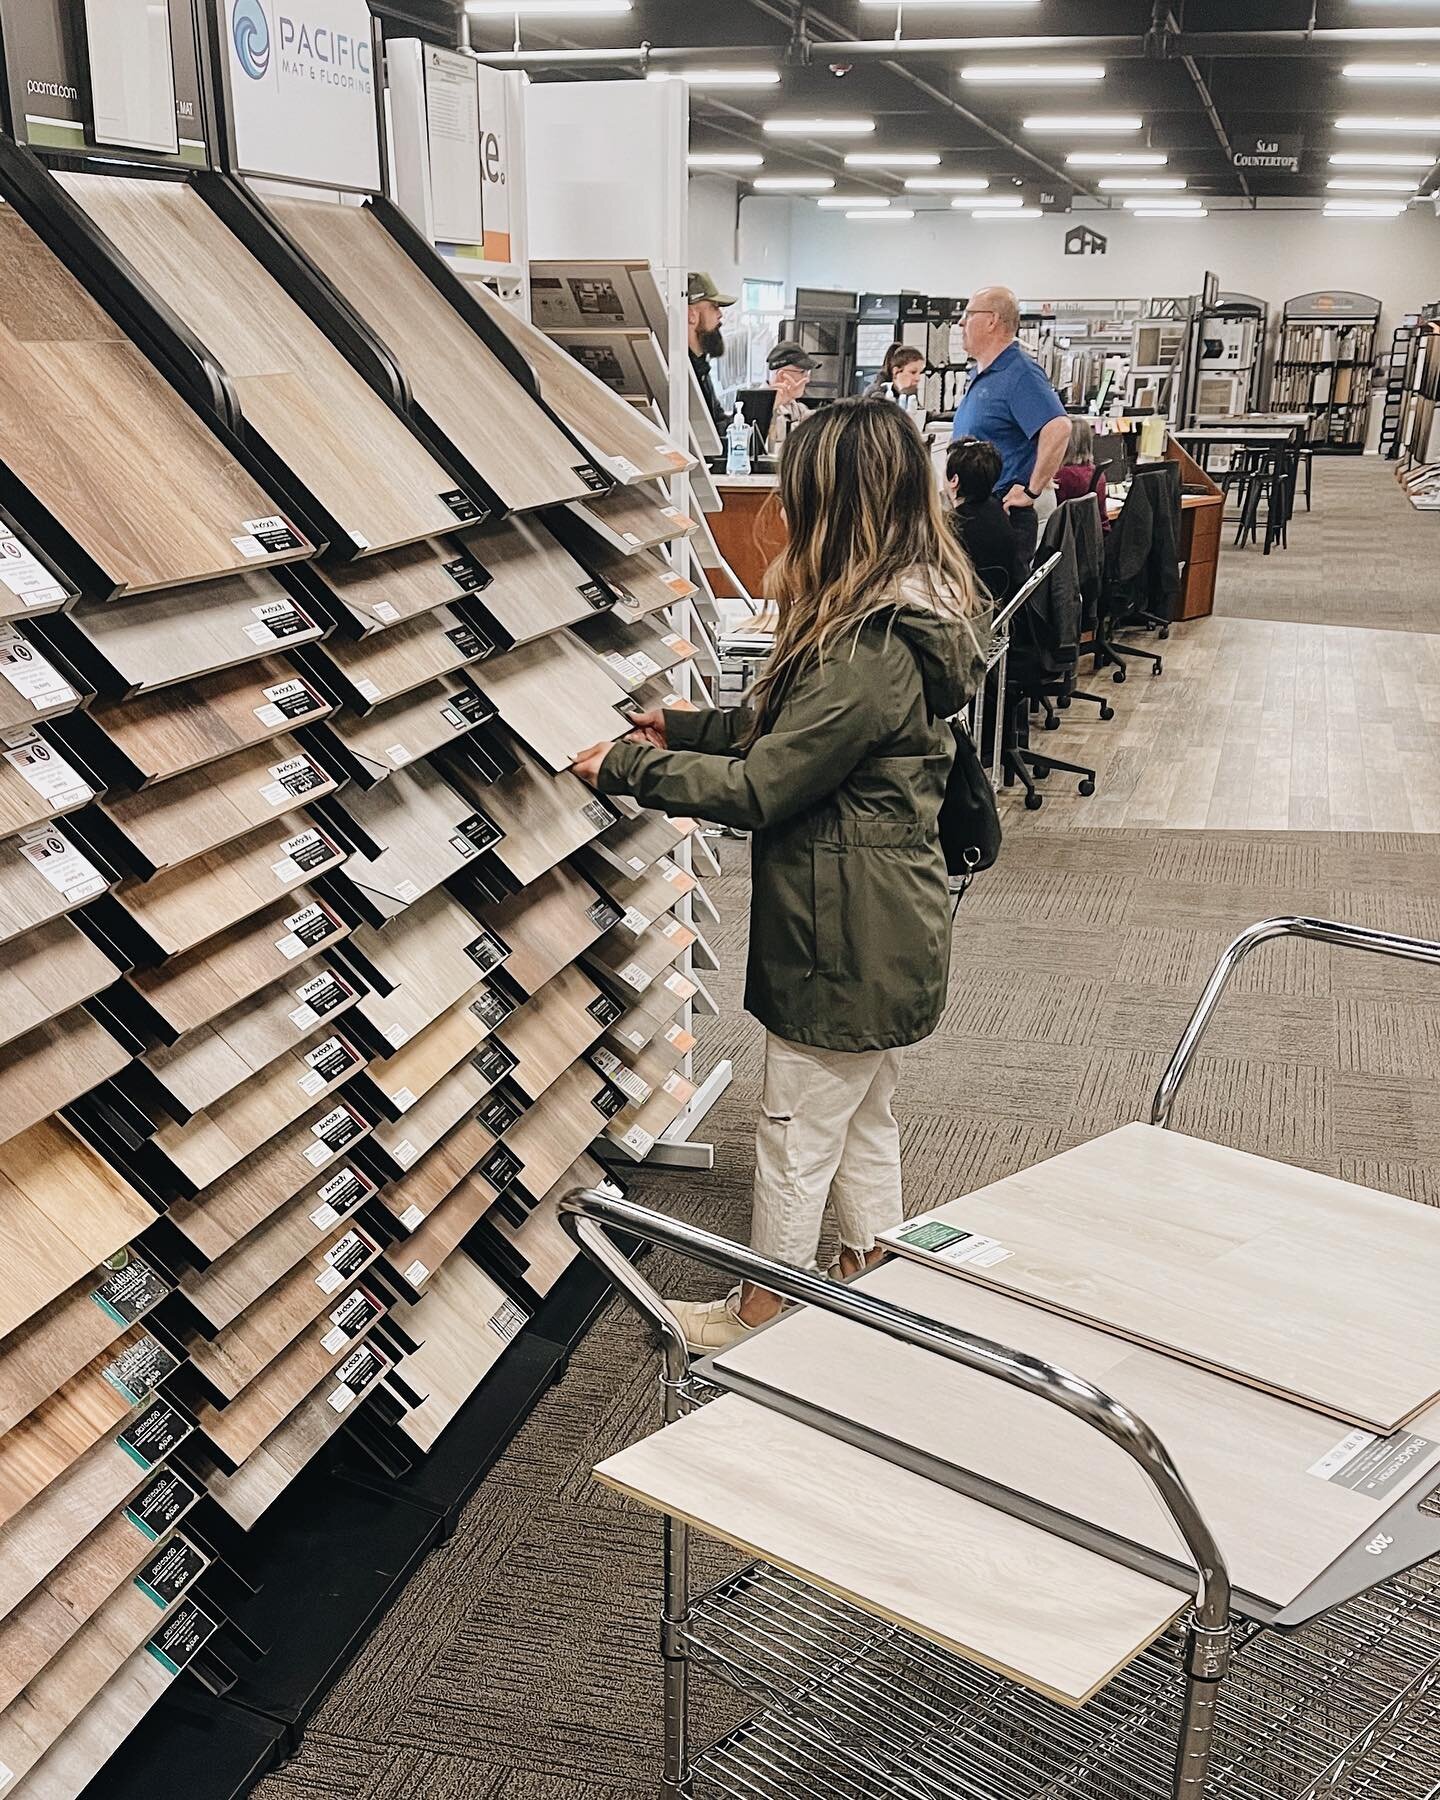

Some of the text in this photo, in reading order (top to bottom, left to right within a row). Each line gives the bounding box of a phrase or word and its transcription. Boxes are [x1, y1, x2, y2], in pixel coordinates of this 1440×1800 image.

[279, 16, 370, 74] PACIFIC
[282, 58, 371, 95] MAT & FLOORING
[27, 79, 78, 100] pacmat.com
[179, 100, 193, 116] MAT
[1256, 139, 1279, 152] SLAB
[1365, 1532, 1394, 1555] 200
